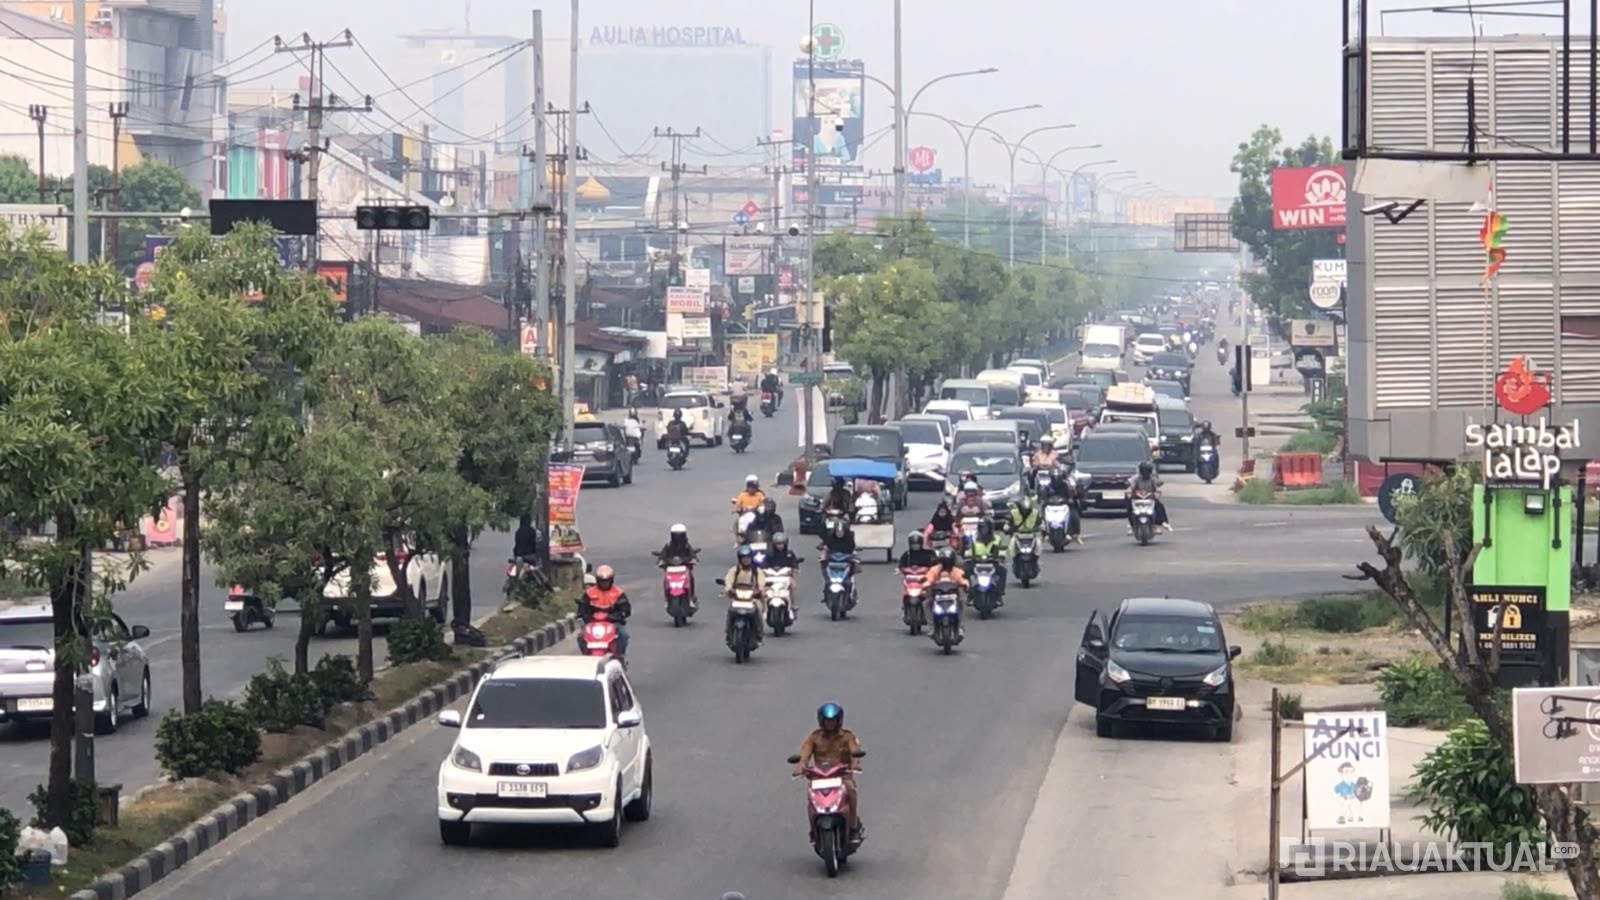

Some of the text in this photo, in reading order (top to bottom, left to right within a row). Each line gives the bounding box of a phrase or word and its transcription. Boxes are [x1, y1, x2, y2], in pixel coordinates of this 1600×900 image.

[590, 25, 747, 45] AULIA HOSPITAL
[1278, 207, 1325, 226] WIN
[1465, 416, 1580, 448] sambal
[1312, 717, 1381, 758] AHLI KUNCI
